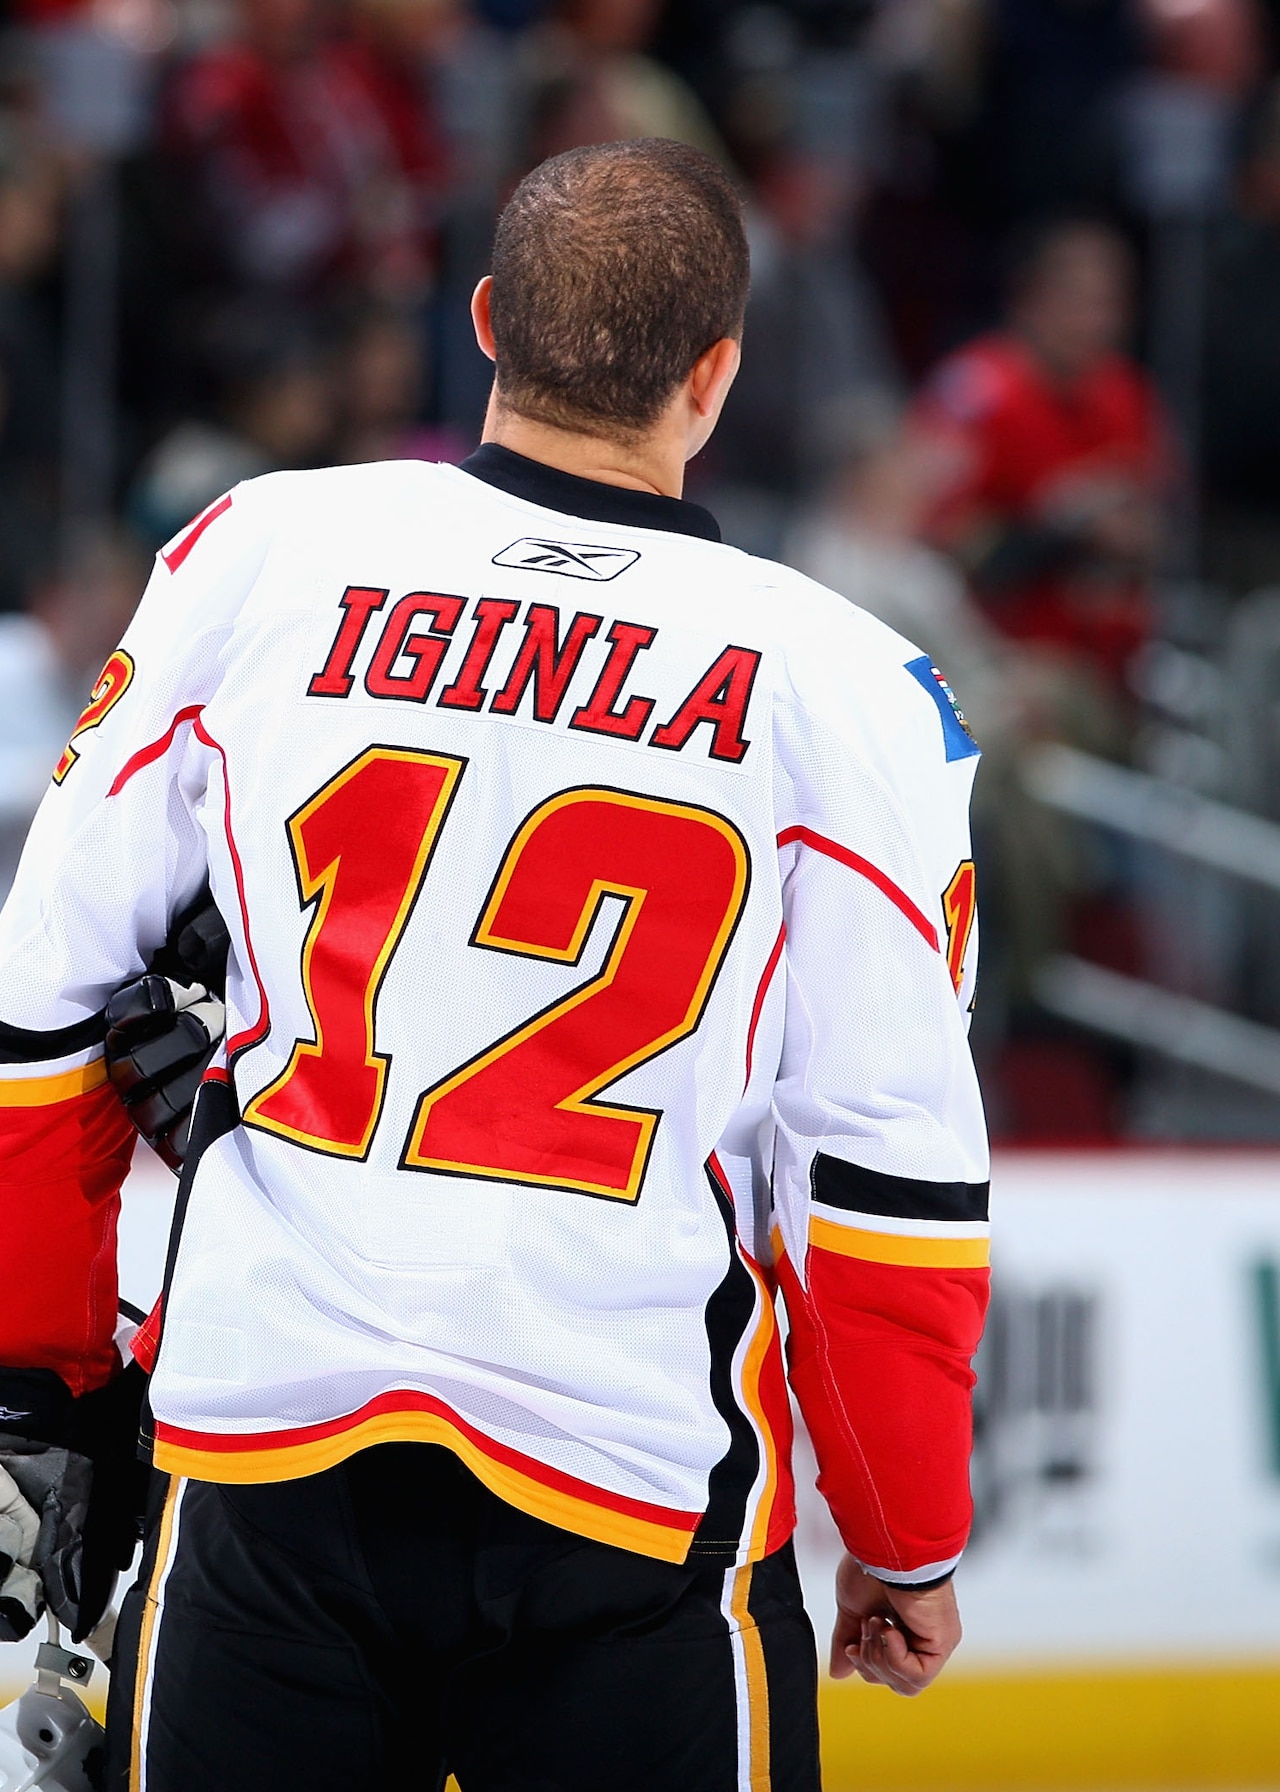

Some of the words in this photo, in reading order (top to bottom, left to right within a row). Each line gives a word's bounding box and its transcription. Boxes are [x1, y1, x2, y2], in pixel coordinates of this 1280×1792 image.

[306, 586, 762, 764] IGINLA
[243, 744, 752, 1206] 12
[940, 859, 977, 1012] 1
